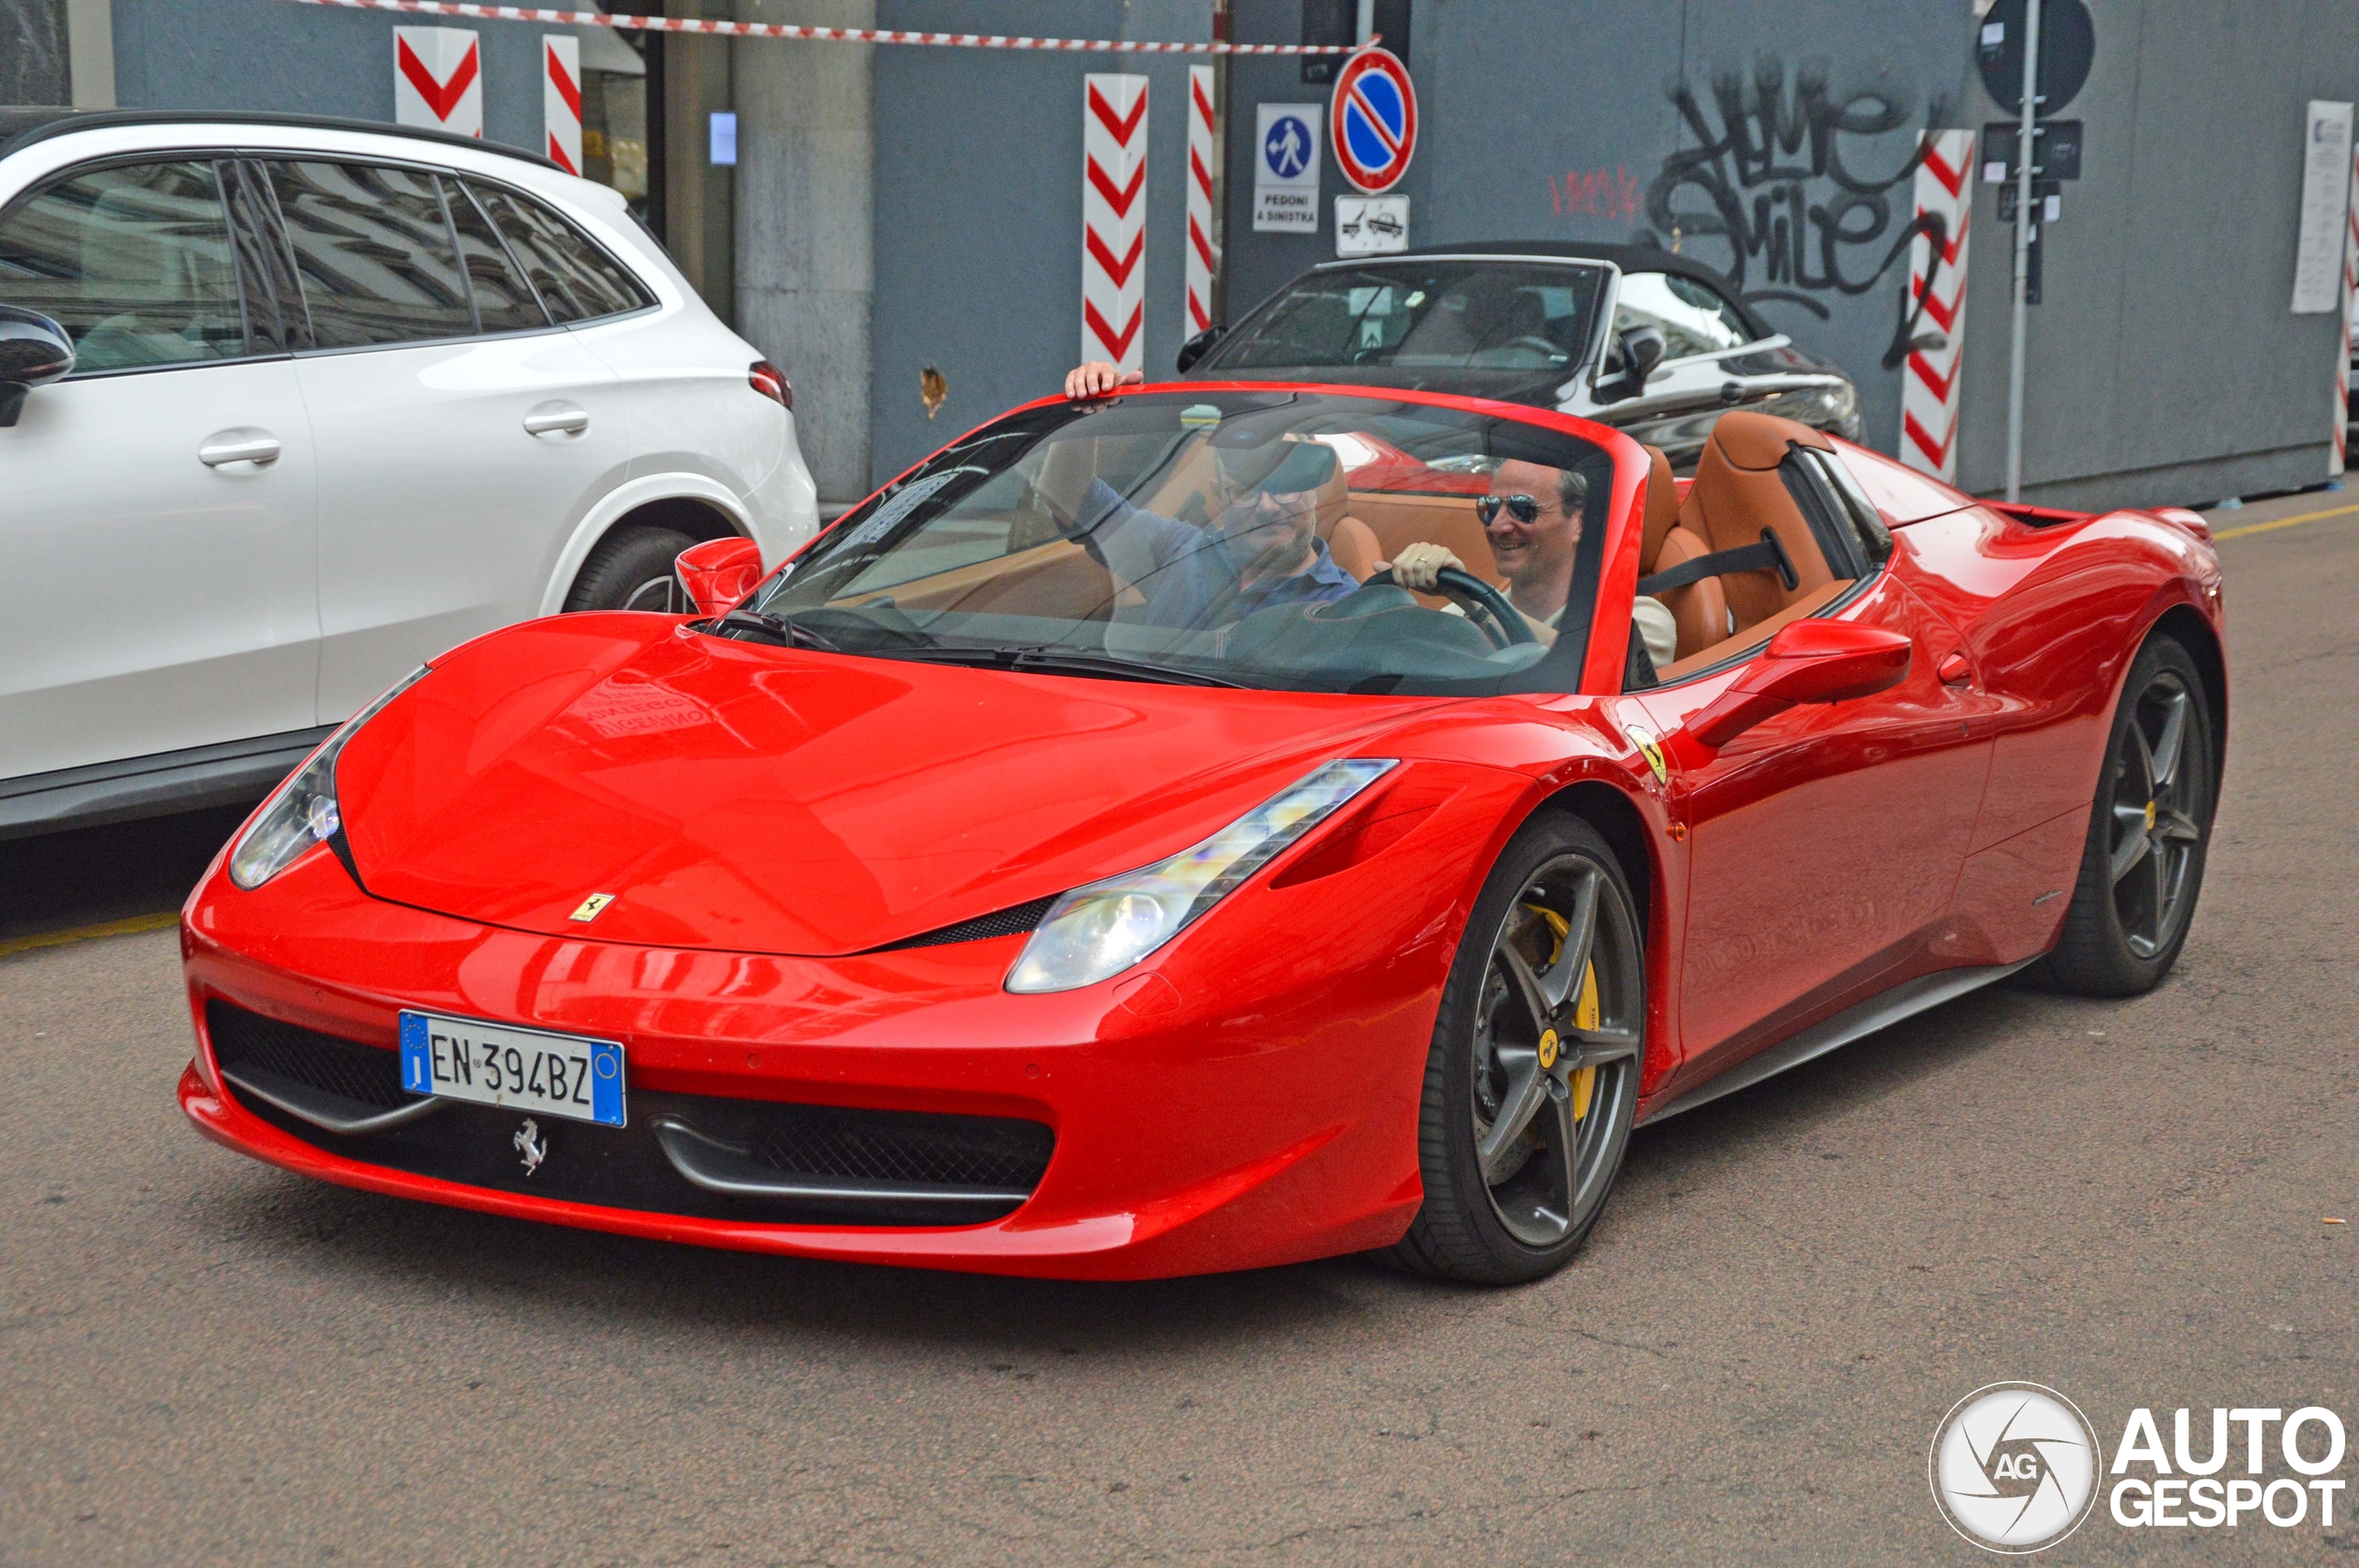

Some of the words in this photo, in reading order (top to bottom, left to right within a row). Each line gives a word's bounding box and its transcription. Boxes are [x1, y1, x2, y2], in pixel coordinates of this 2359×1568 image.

[1265, 193, 1309, 205] PEDONI
[1257, 210, 1264, 221] A
[1268, 210, 1315, 222] SINISTRA
[431, 1034, 471, 1085] EN
[482, 1043, 590, 1106] 394BZ
